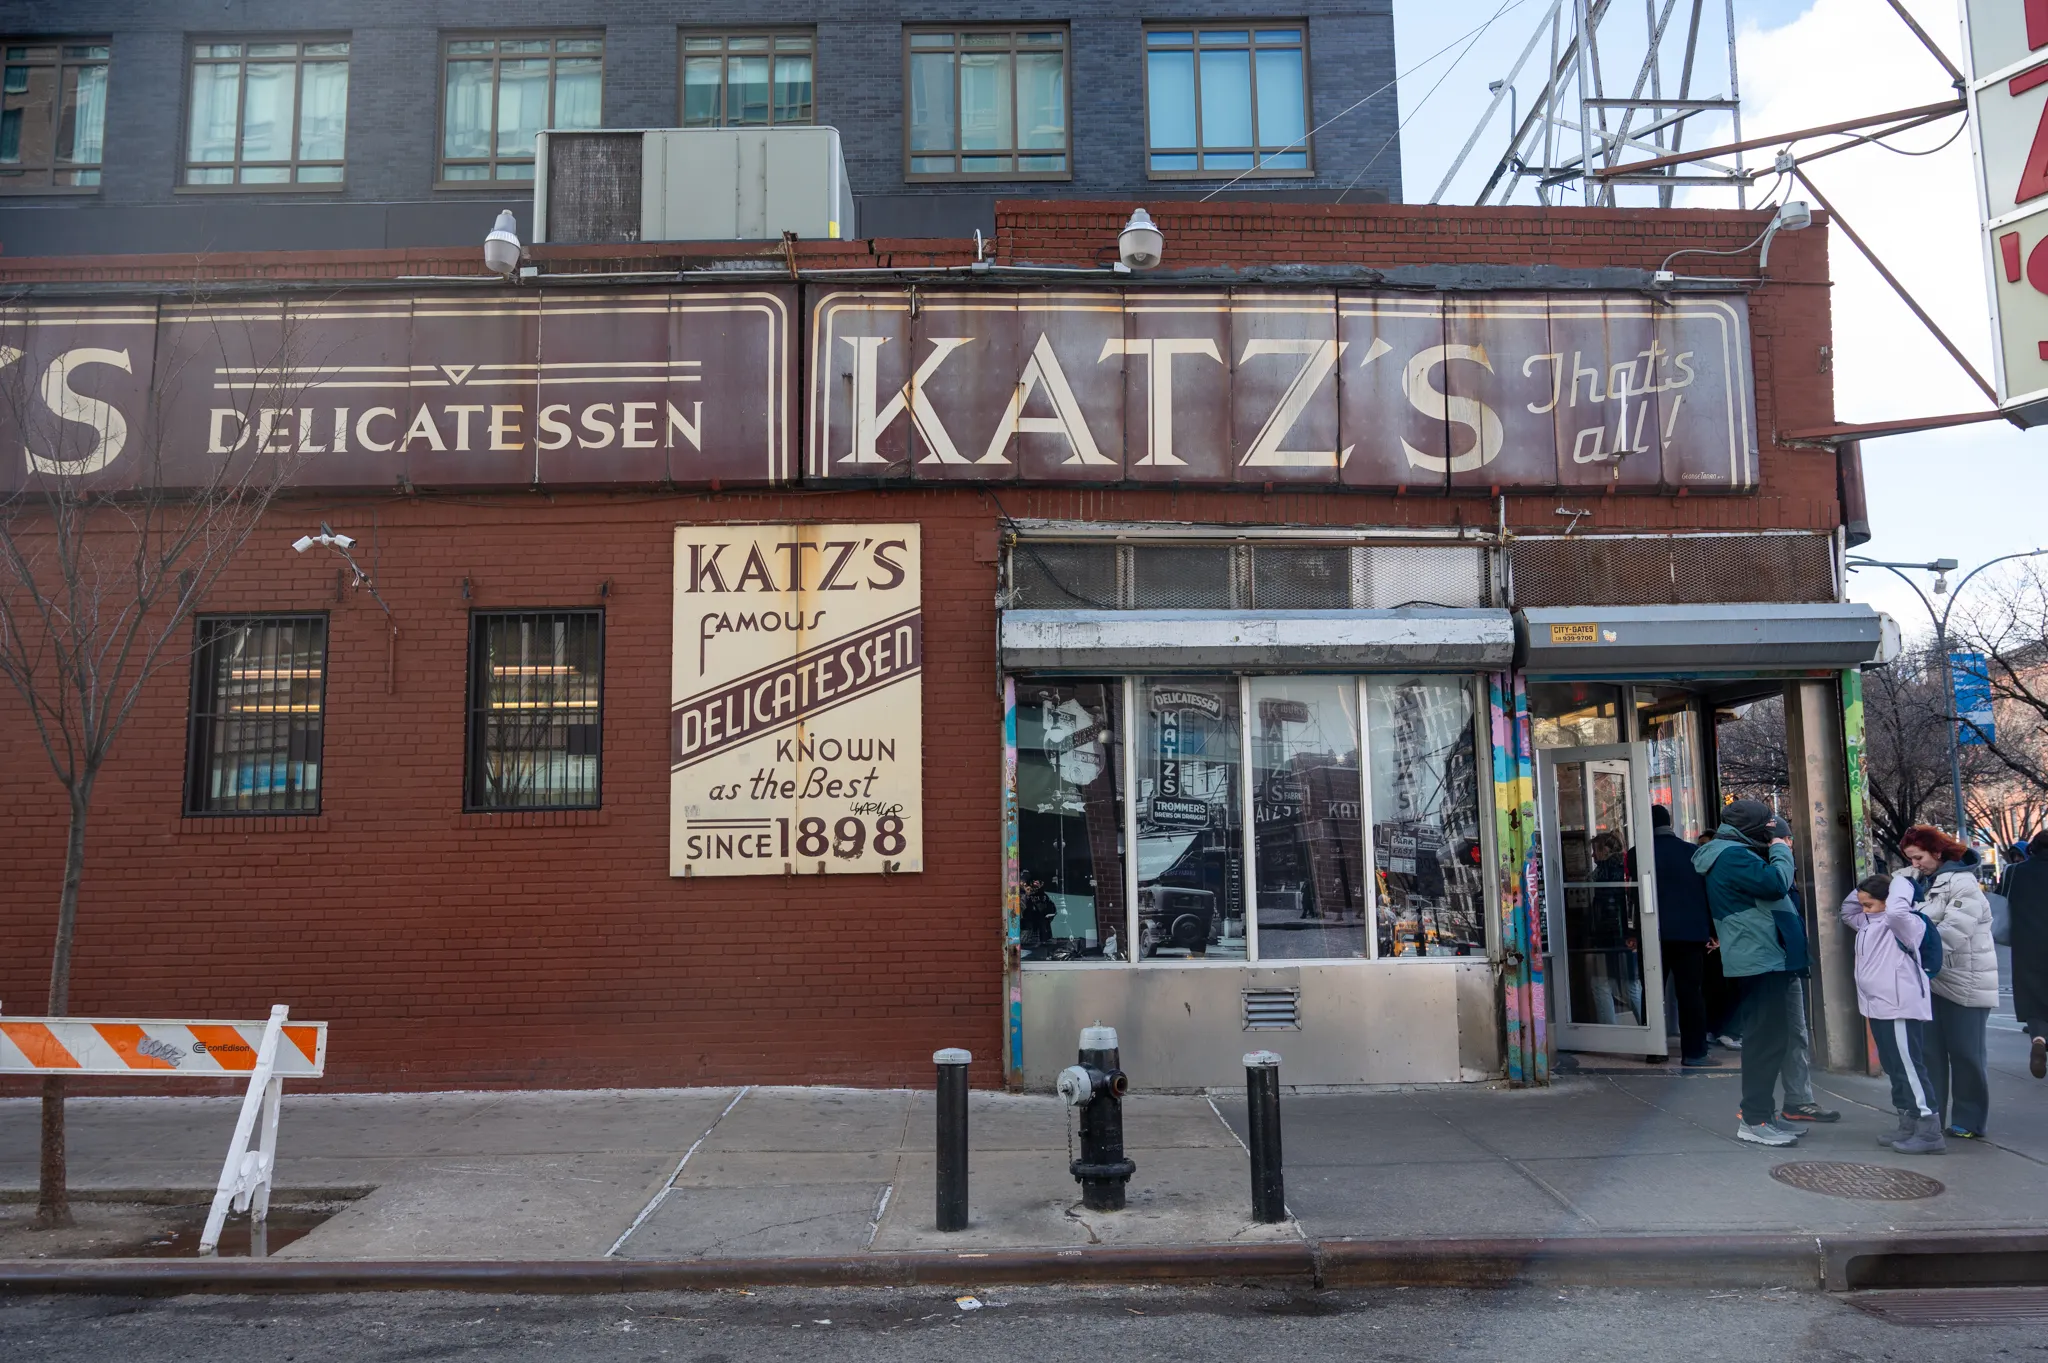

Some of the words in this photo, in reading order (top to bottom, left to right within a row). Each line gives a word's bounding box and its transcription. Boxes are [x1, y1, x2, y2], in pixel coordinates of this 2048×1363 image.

[1523, 339, 1695, 414] That's
[837, 332, 1503, 473] KATZ'S
[207, 401, 703, 454] DELICATESSEN
[1573, 394, 1683, 464] all!
[684, 538, 908, 593] KATZ'S
[700, 610, 826, 678] FAMOUS
[681, 625, 913, 756] DELICATESSEN
[1155, 691, 1219, 713] DELICATESSEN
[776, 738, 895, 762] KNOWN
[1163, 711, 1177, 793] KATZ'S
[709, 783, 741, 800] as
[750, 767, 796, 800] the
[798, 766, 879, 799] Best
[1155, 801, 1206, 813] TROMMER'S
[1182, 813, 1206, 821] DRAUGHT
[686, 834, 773, 860] SINCE
[775, 816, 907, 861] 1898
[1392, 847, 1414, 855] FAST
[1393, 837, 1414, 846] PARK
[207, 1044, 250, 1052] conEdison
